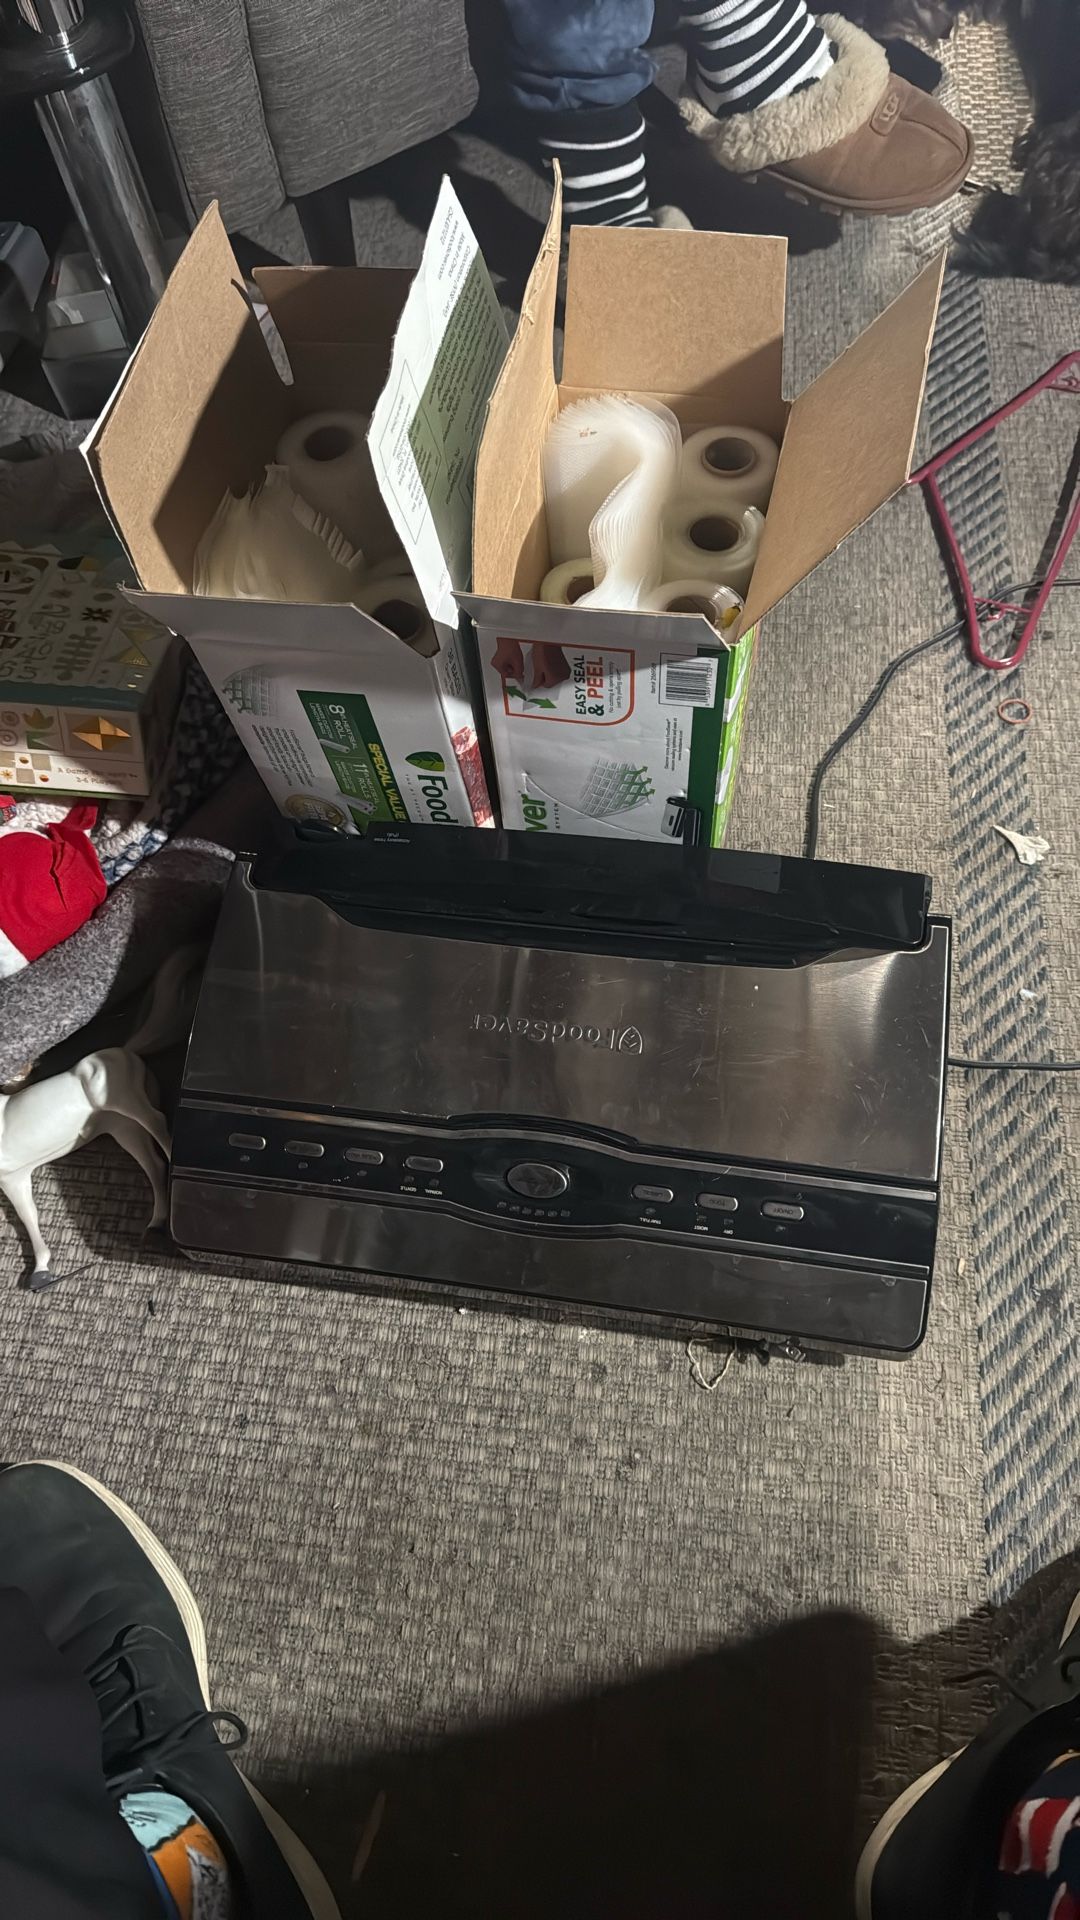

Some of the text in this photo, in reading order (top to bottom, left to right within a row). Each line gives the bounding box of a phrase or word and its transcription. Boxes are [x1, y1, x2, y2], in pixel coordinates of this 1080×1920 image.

[573, 655, 587, 715] EASY SEAL
[586, 656, 605, 717] & PEEL
[329, 704, 346, 714] 8
[332, 720, 347, 737] ROLL
[367, 742, 407, 820] SPECIAL VALUE
[417, 774, 459, 824] Food
[470, 1013, 615, 1050] FoodSaver
[400, 1185, 417, 1193] GENTLE
[424, 1188, 443, 1196] NORMAL
